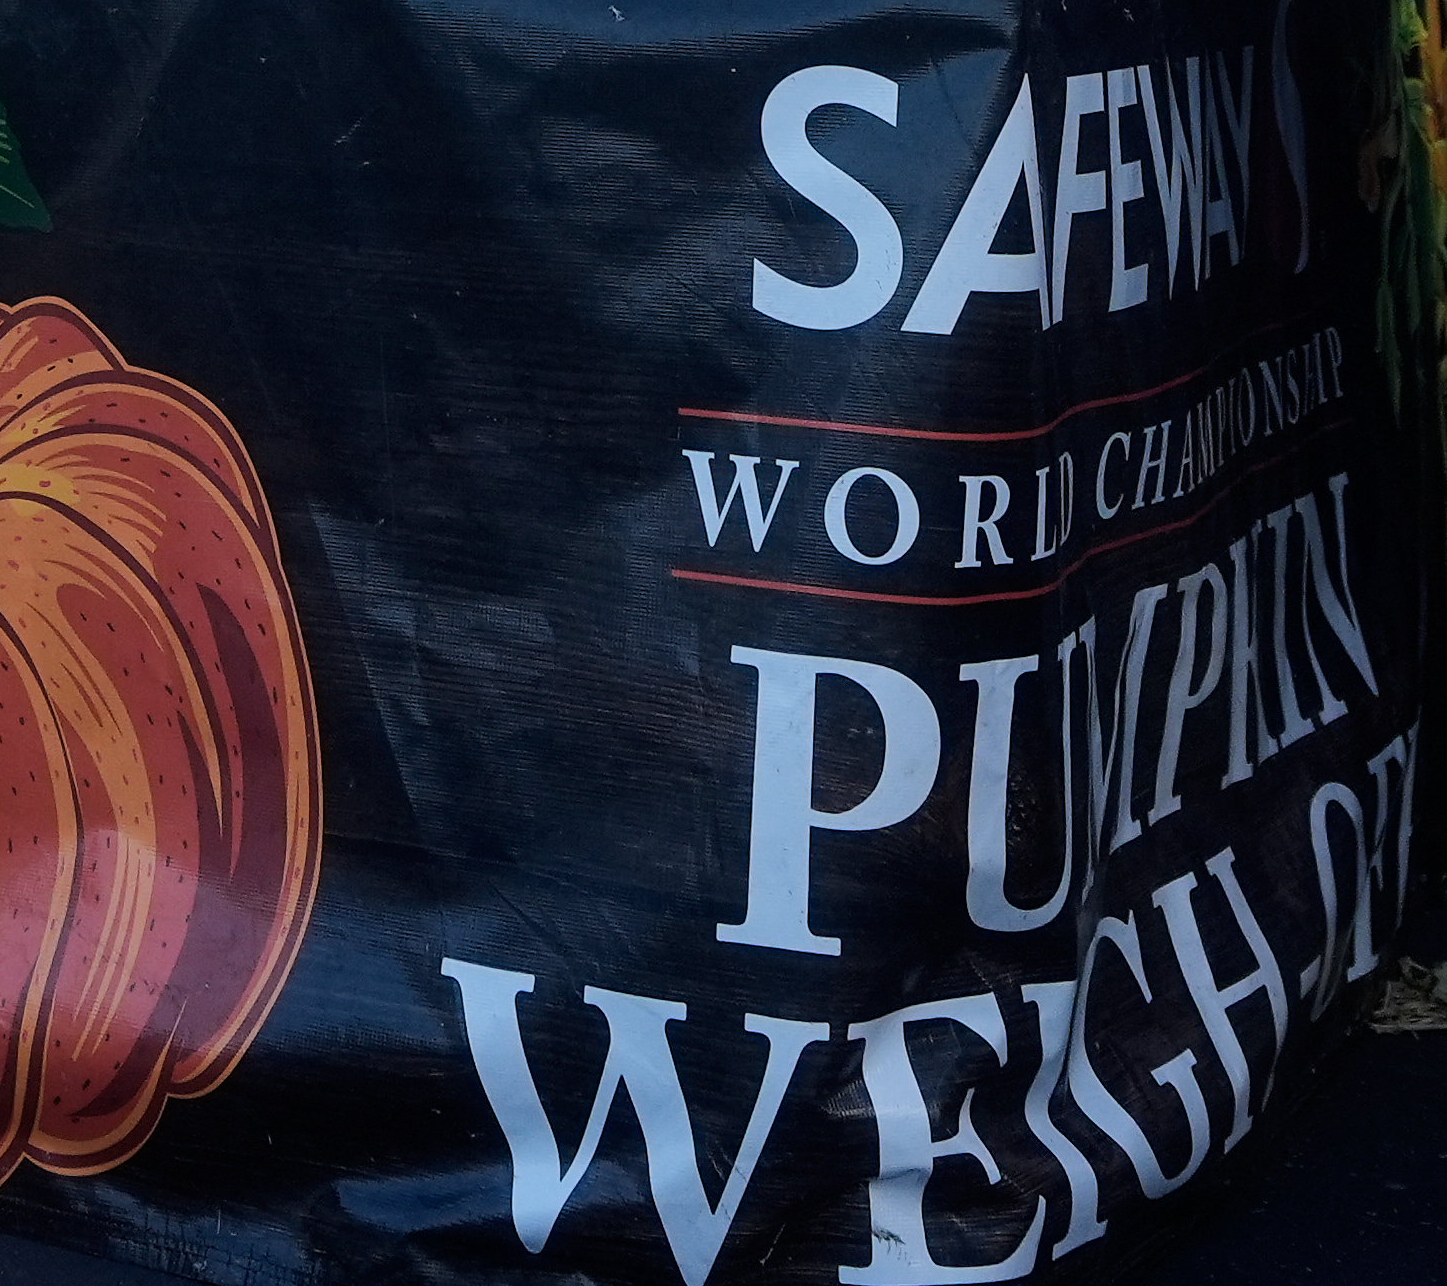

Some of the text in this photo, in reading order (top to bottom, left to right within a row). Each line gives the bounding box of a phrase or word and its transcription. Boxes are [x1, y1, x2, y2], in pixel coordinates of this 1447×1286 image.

[751, 40, 1255, 336] SAFEWAY
[682, 325, 1345, 571] WORLD CHAMPIONSHIP
[715, 471, 1381, 958] PUMPKIN
